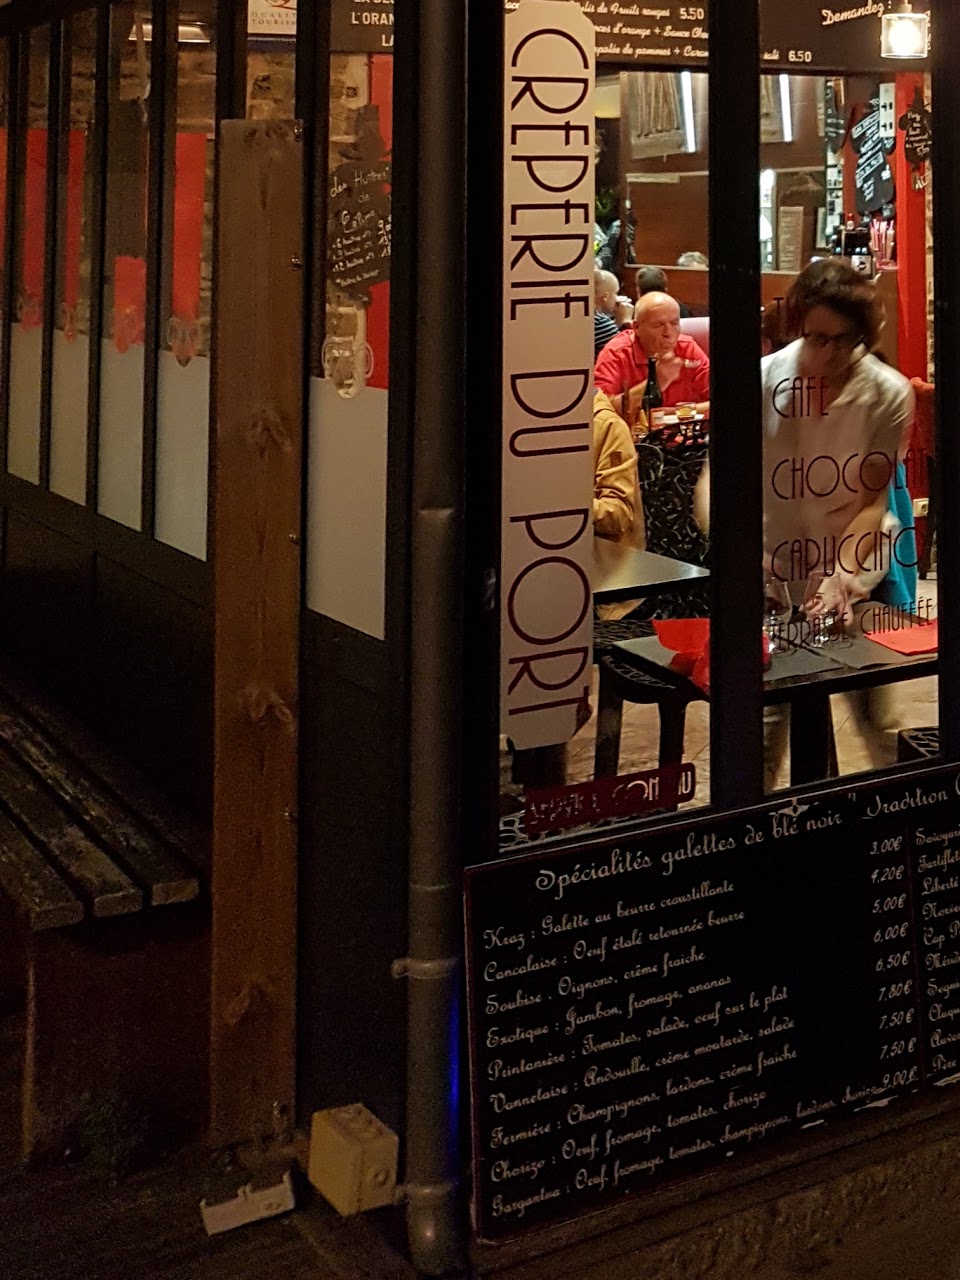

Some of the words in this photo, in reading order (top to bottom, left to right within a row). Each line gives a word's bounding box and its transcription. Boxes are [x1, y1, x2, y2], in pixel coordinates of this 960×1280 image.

[510, 28, 590, 322] CREPERIE
[508, 367, 590, 458] DU
[772, 375, 830, 419] CAFE
[507, 508, 591, 717] PORT
[860, 598, 934, 637] CHAUFFÉE
[535, 848, 653, 901] Spécialités
[660, 832, 737, 876] galettes
[744, 824, 765, 845] de
[806, 810, 842, 831] noir
[594, 913, 612, 924] au
